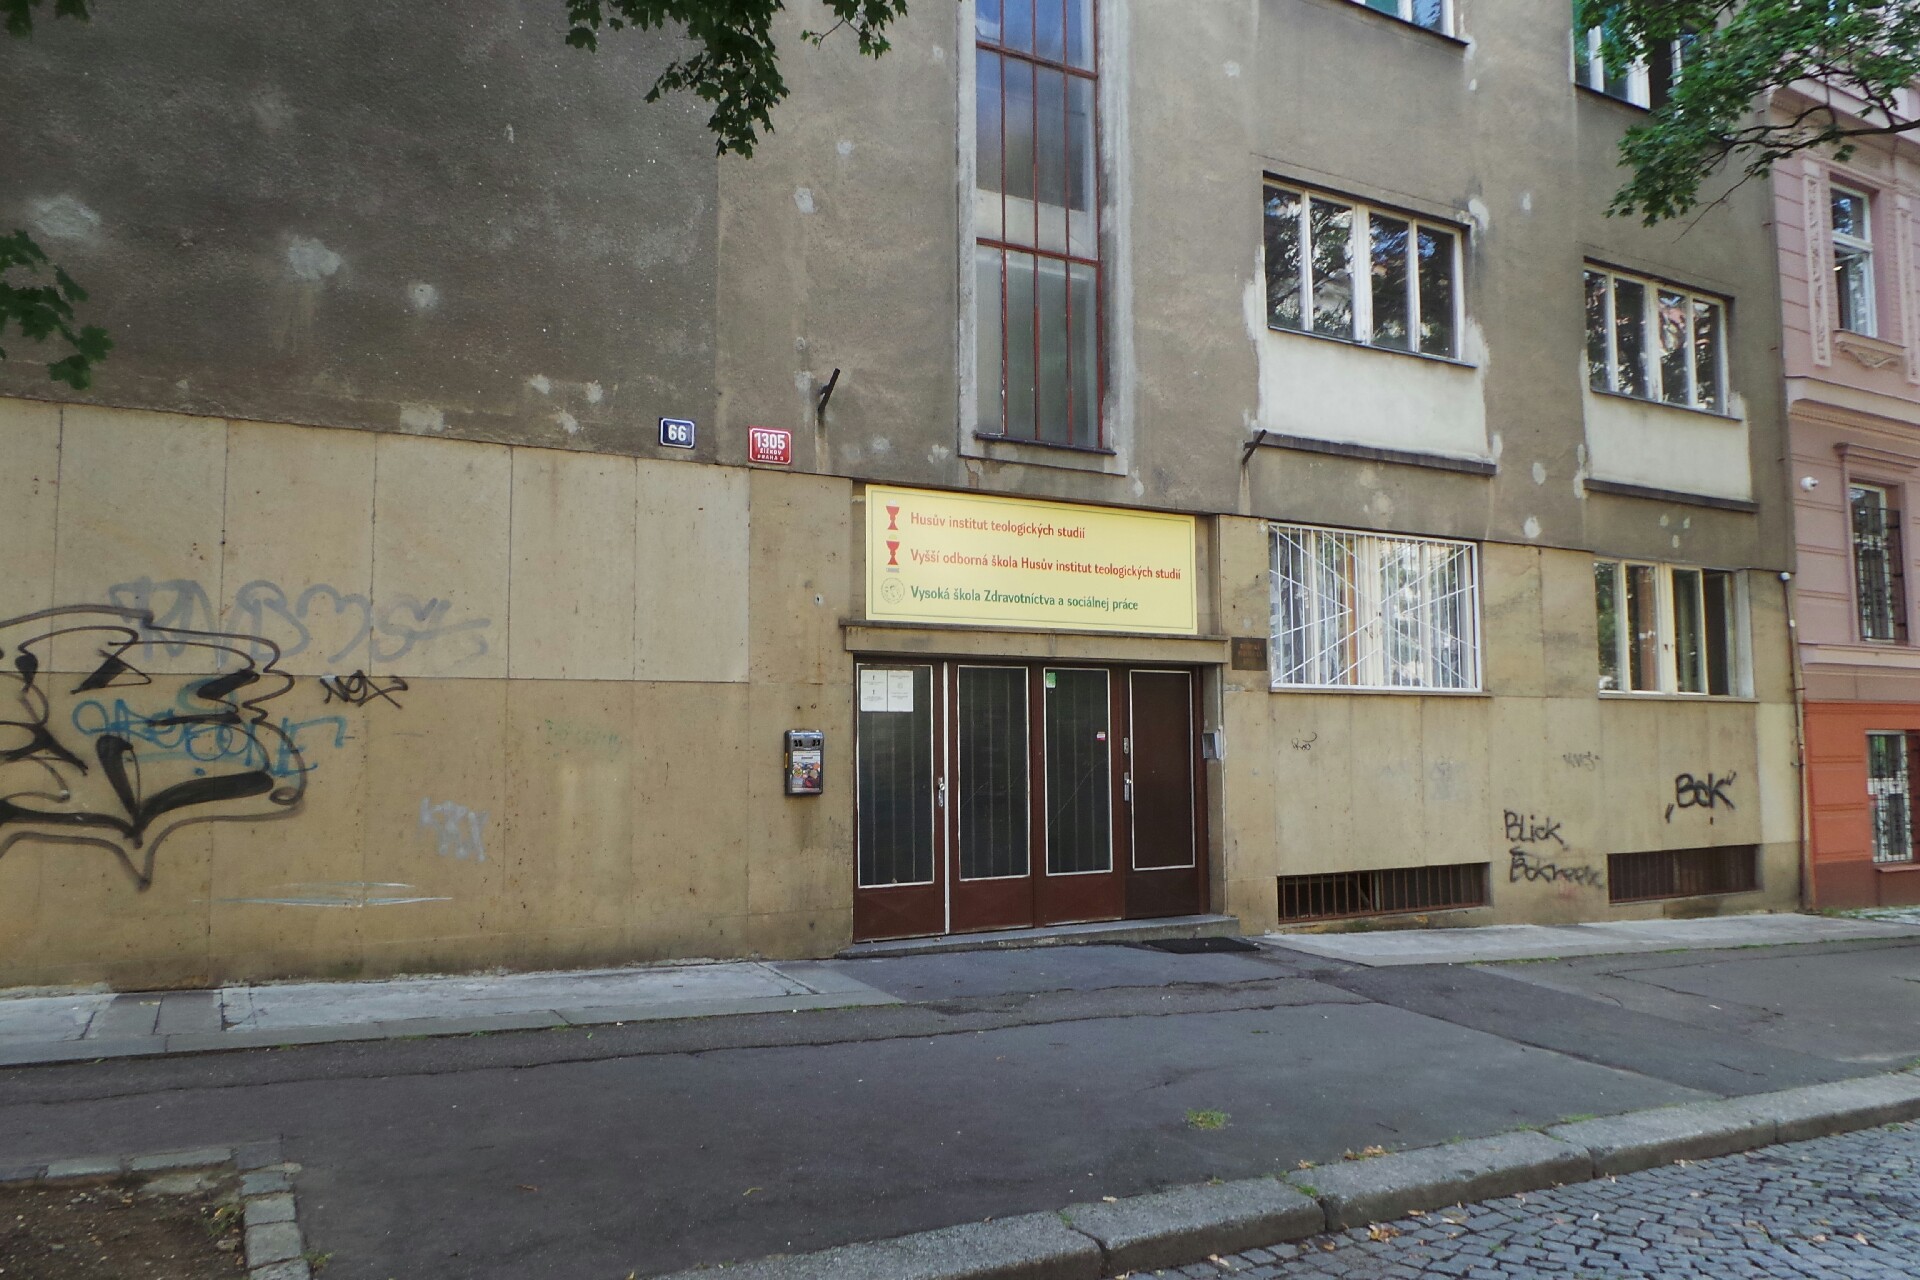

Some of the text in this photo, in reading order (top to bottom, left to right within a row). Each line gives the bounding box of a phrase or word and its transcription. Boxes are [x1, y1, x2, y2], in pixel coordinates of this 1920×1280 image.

[669, 424, 687, 441] 66
[754, 432, 786, 450] 1305
[911, 512, 1086, 539] Husův institut teologických studií
[910, 548, 1181, 580] Vyšší odborná škola Husův institut teologických studií
[910, 585, 1139, 612] Vysoká škola Zdravotníctva a sociálnej práce
